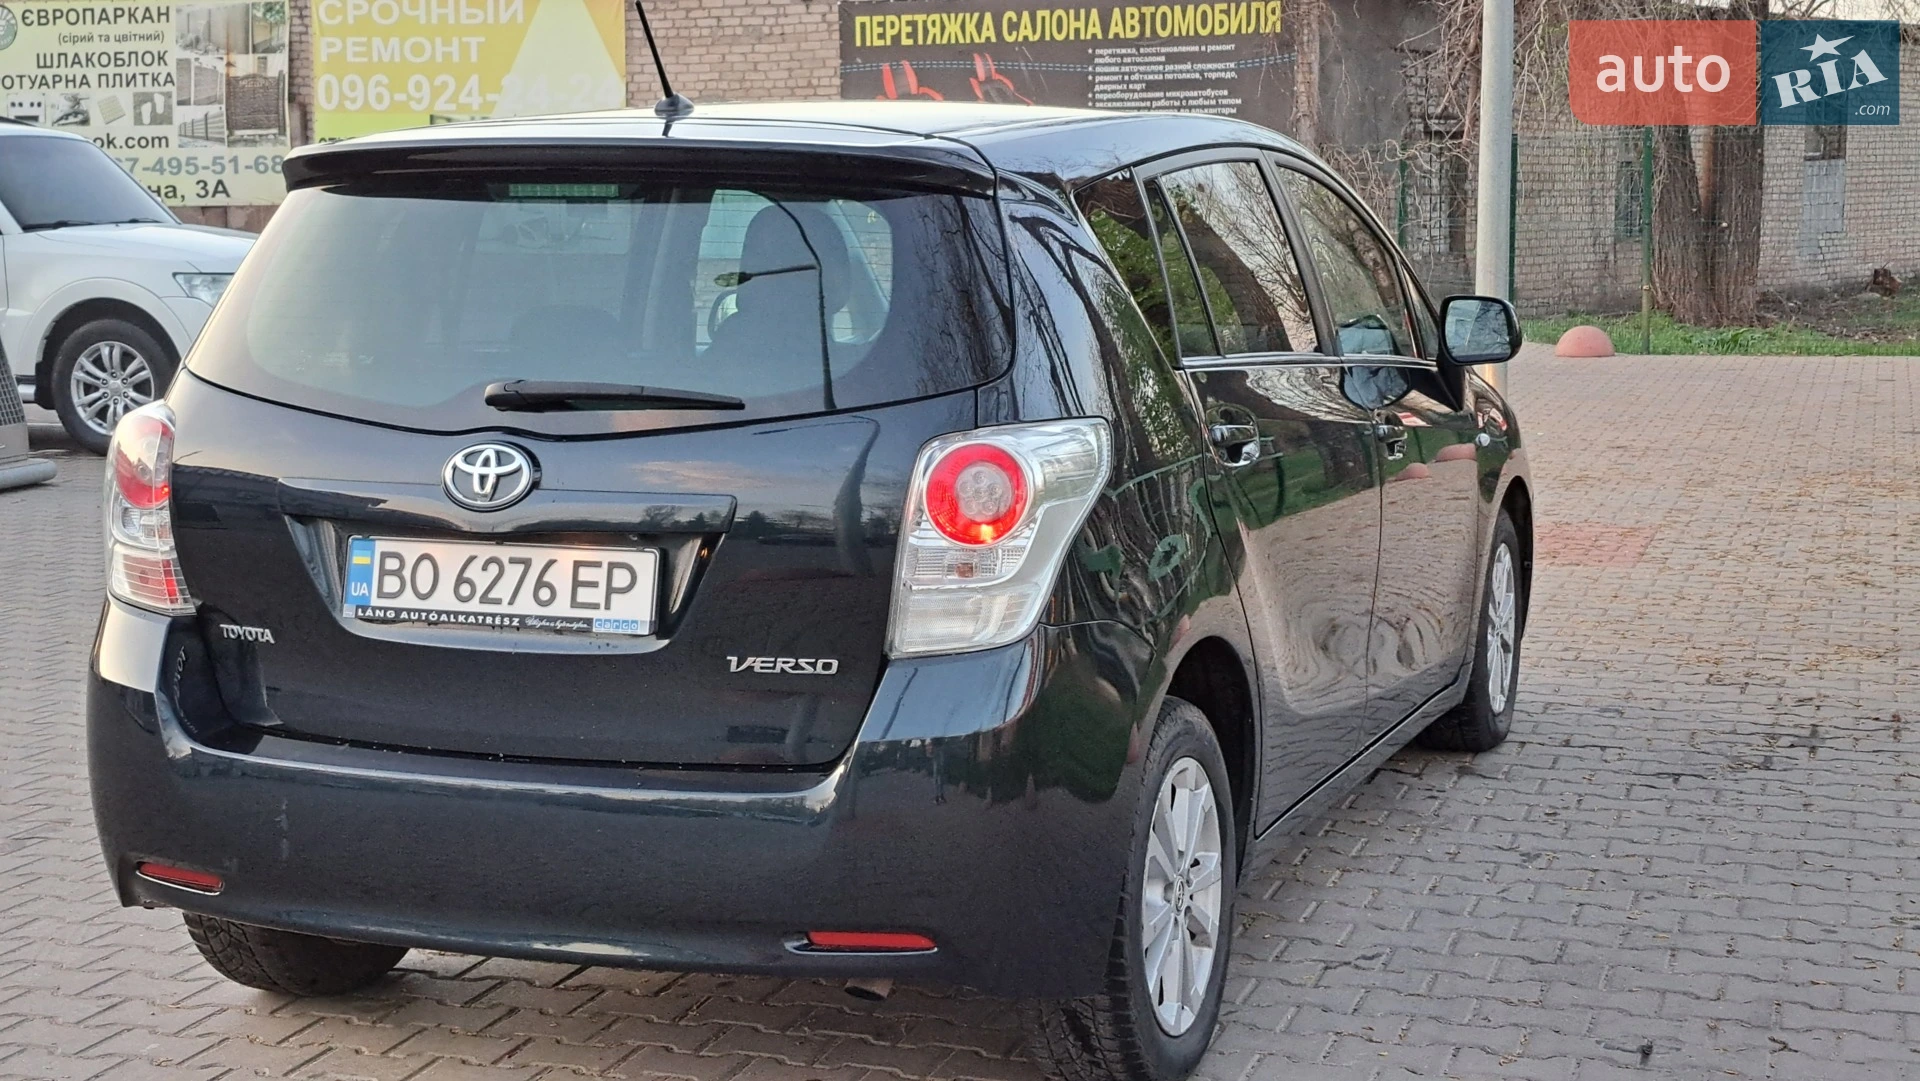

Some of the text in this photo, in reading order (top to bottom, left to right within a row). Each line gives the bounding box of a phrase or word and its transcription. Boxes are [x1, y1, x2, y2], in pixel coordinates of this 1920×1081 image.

[21, 6, 170, 27] ЄВРОПАРКАН
[854, 1, 1281, 47] ПЕРЕТЯЖКА САЛОНА АВТОМОБИЛЯ
[58, 30, 165, 46] (сірий та цвітний)
[319, 37, 486, 63] РЕМОНТ
[1095, 48, 1139, 56] перетяжка,
[1139, 45, 1199, 54] восстановление
[1207, 44, 1236, 53] ремонт
[36, 50, 169, 69] ШЛАКОБЛОК
[1094, 55, 1166, 64] любого автосалона
[1165, 62, 1191, 72] разной
[98, 72, 176, 88] ПЛИТКА
[1095, 74, 1122, 83] ремонт
[1131, 72, 1164, 81] обтяжка
[1204, 71, 1238, 80] торпедо,
[1094, 82, 1146, 92] дверных карт
[1095, 89, 1228, 100] переоборудование микроавтобусов
[1152, 99, 1180, 108] работы
[1188, 98, 1216, 106] любым
[115, 154, 284, 177] 7-495-51-68
[376, 550, 637, 610] BO 6276 EP
[351, 582, 369, 597] UA
[357, 606, 396, 618] LÁNG
[400, 608, 521, 626] AUTÓALKATRÉSZ
[219, 624, 275, 644] TOYOTA
[726, 656, 839, 675] VERSO
